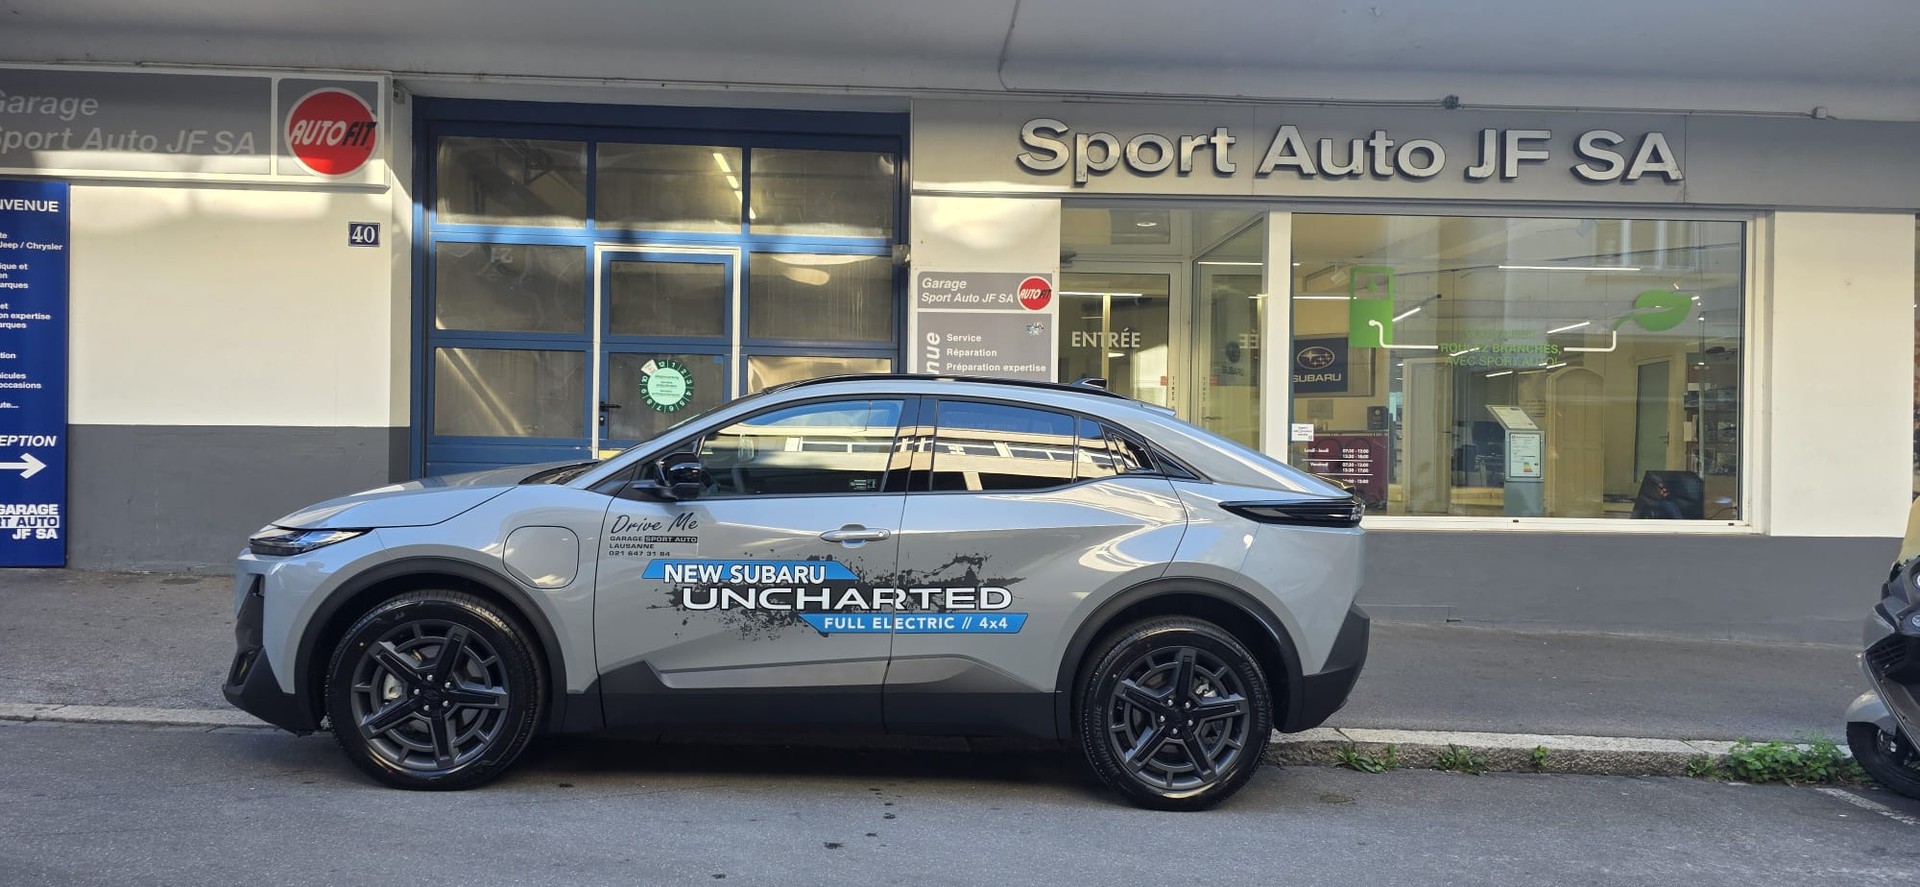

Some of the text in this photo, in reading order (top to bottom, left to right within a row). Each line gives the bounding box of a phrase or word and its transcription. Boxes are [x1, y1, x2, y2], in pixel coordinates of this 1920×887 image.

[289, 119, 378, 147] AUTOFIT
[0, 126, 256, 154] port Auto JF SA
[1016, 117, 1684, 185] Sport Auto JF SA
[351, 225, 376, 244] 40
[26, 242, 63, 251] Chrysler
[921, 277, 967, 291] Garage
[921, 292, 1014, 304] Sport Auto JF SA
[10, 313, 51, 321] expertise
[946, 333, 982, 342] Service
[1071, 327, 1141, 348] ENTRÉE
[946, 348, 998, 358] Réparation
[946, 362, 1047, 373] Préparation expertise
[1293, 373, 1341, 383] SUBARU
[16, 516, 58, 527] AUTO
[610, 512, 699, 534] Drive Me
[12, 528, 58, 539] JF SA
[663, 564, 826, 585] NEW SUBARU
[682, 587, 1013, 611] UNCHARTED
[824, 616, 866, 629] FULL
[872, 617, 955, 629] ELECTRIC
[979, 617, 1008, 629] 4x4
